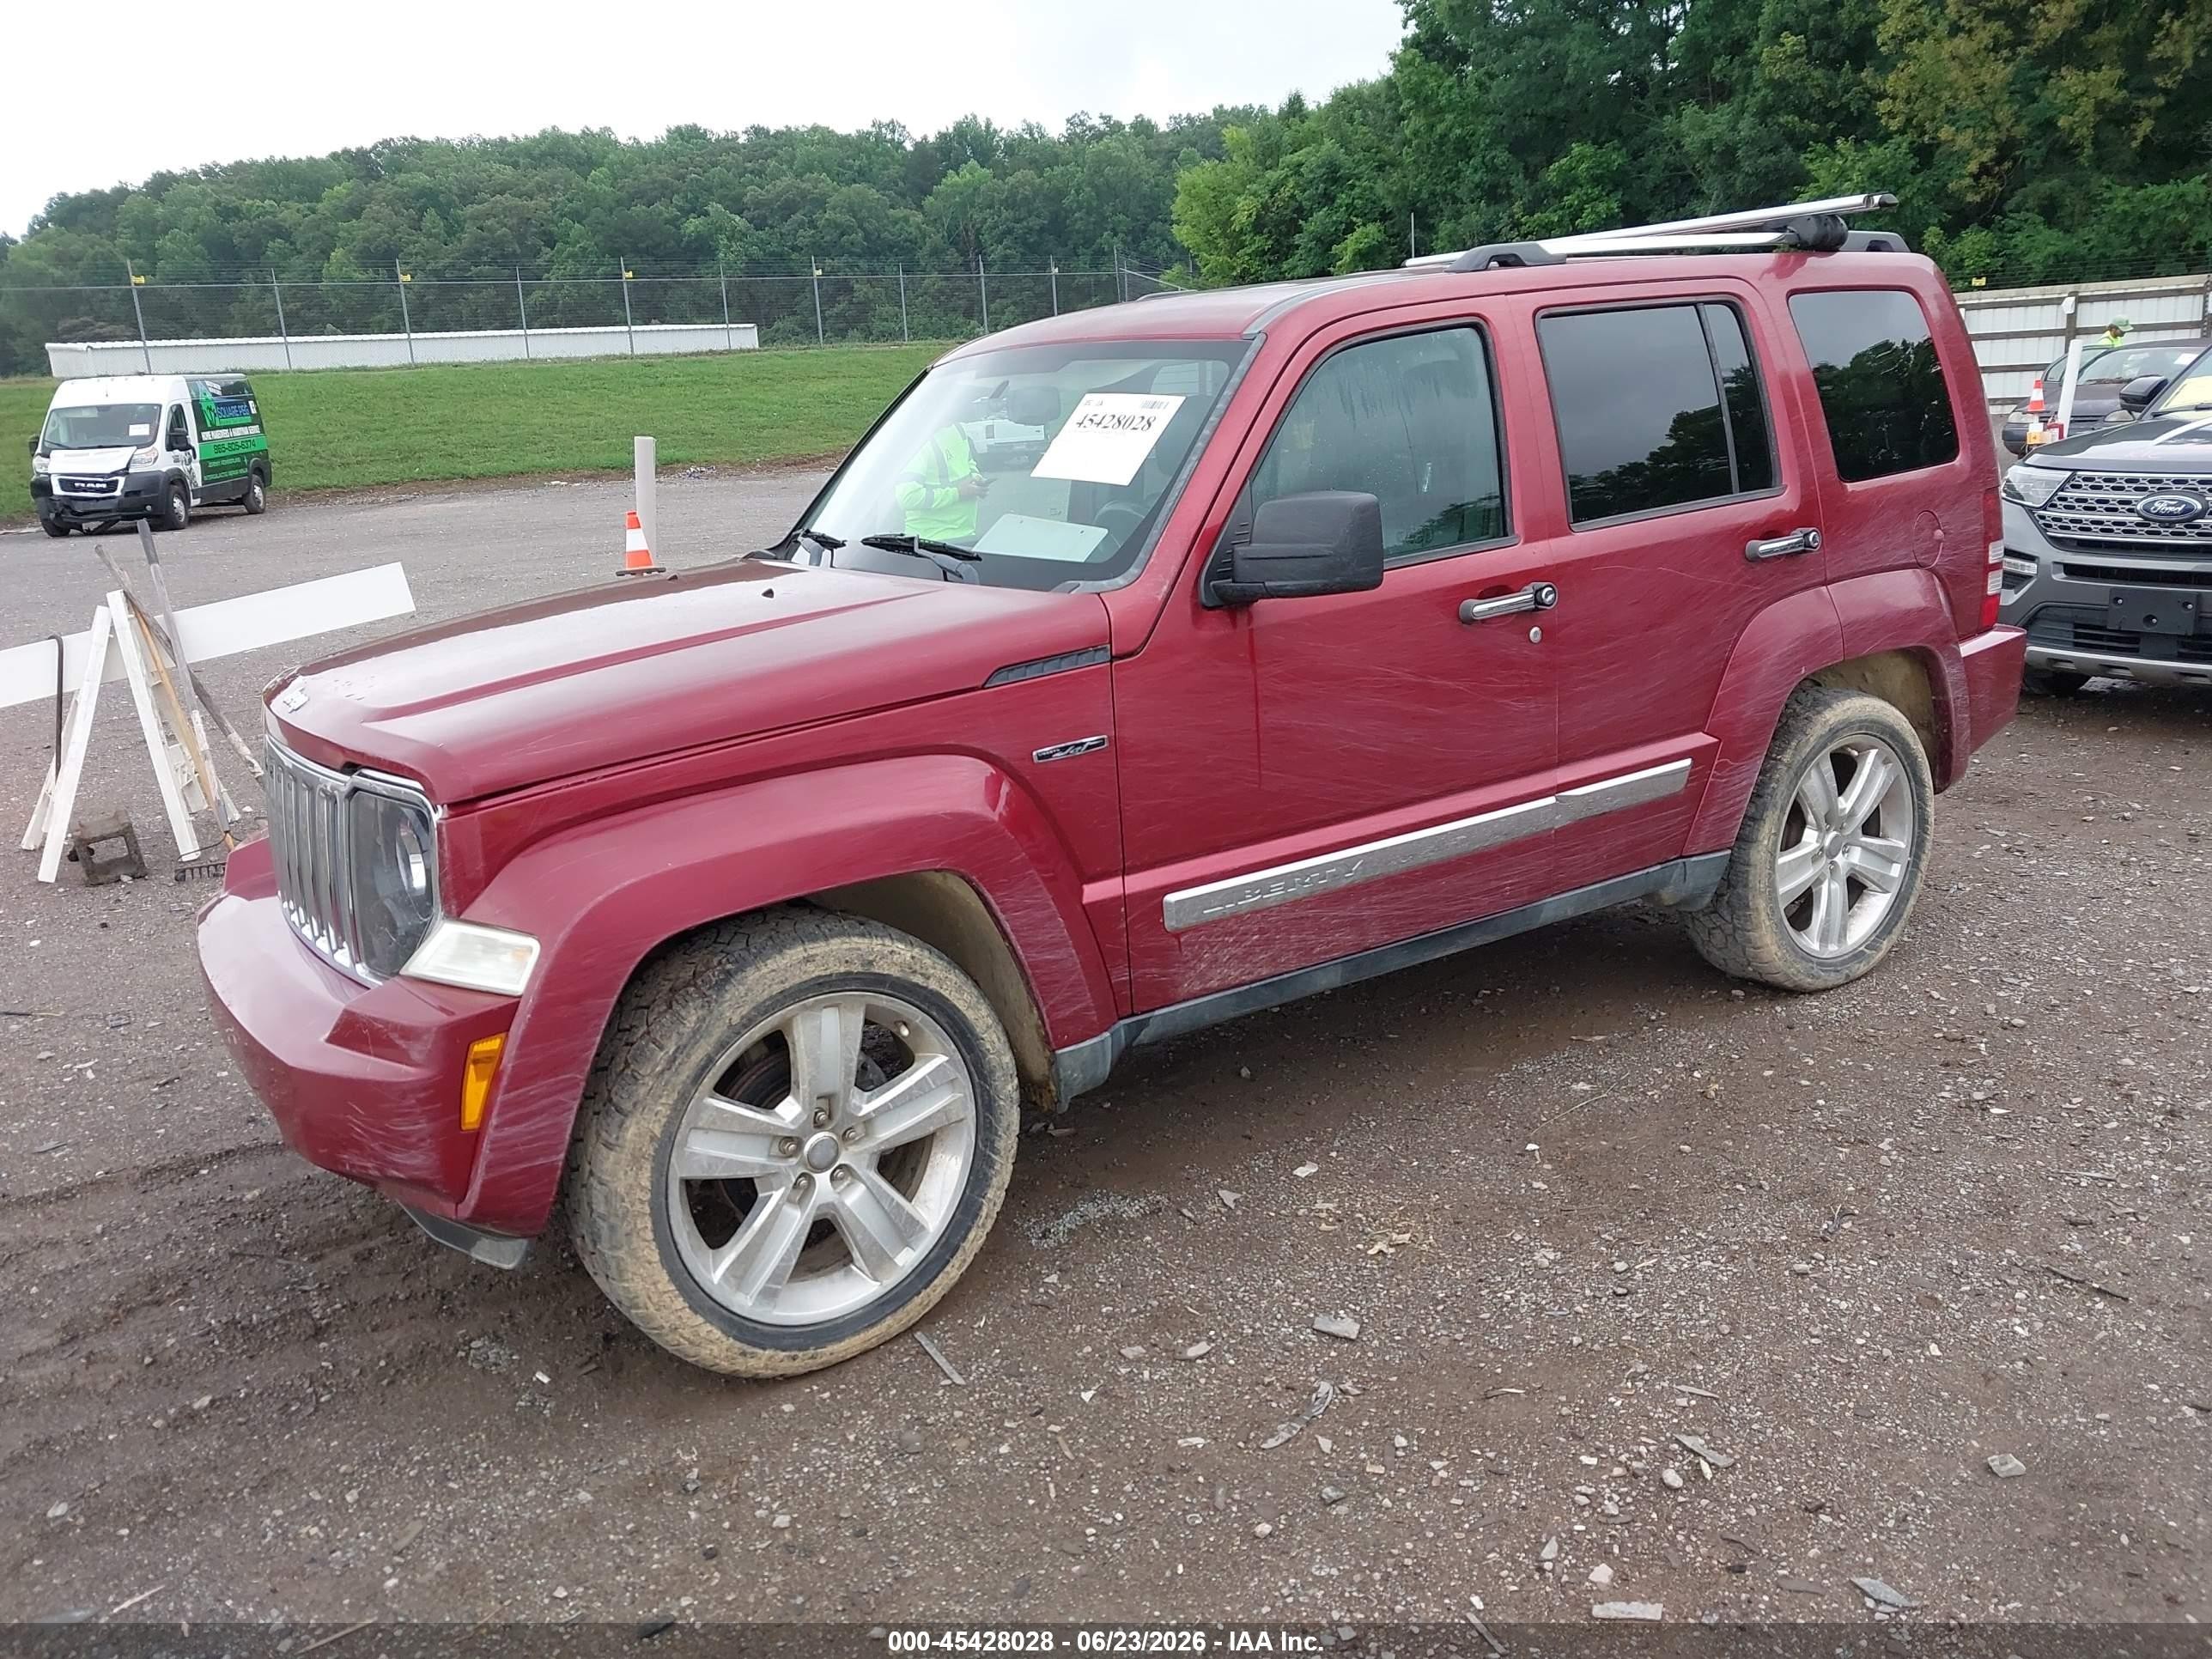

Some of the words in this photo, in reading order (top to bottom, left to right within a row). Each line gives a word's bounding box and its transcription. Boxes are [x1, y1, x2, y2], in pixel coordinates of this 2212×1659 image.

[1076, 413, 1157, 432] 45428028
[2150, 500, 2186, 514] Ford
[1203, 860, 1364, 915] LIBERTY
